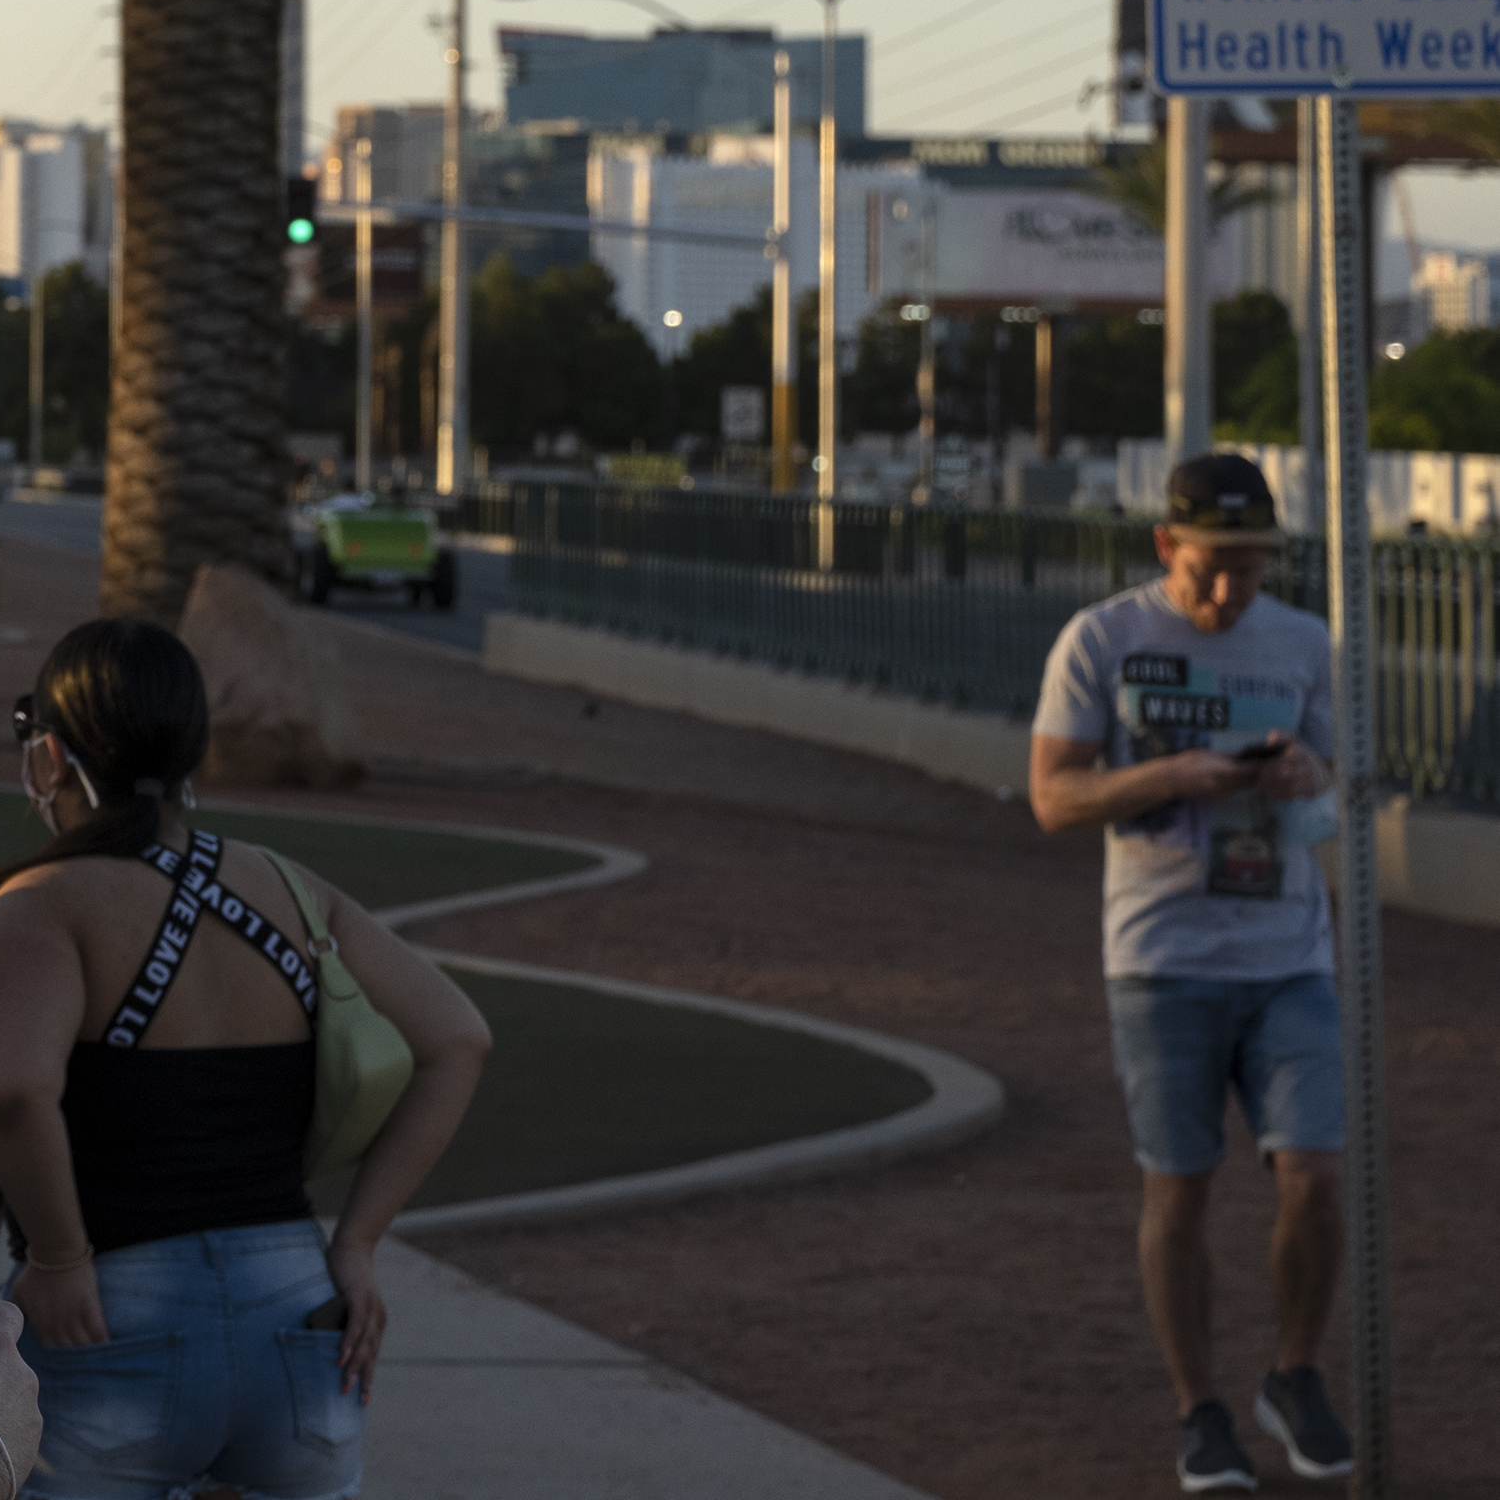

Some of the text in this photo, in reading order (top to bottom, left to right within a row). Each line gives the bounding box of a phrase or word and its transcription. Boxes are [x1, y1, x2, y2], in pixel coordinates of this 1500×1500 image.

[1177, 18, 1500, 71] Health Week
[133, 921, 189, 1007] LOVE
